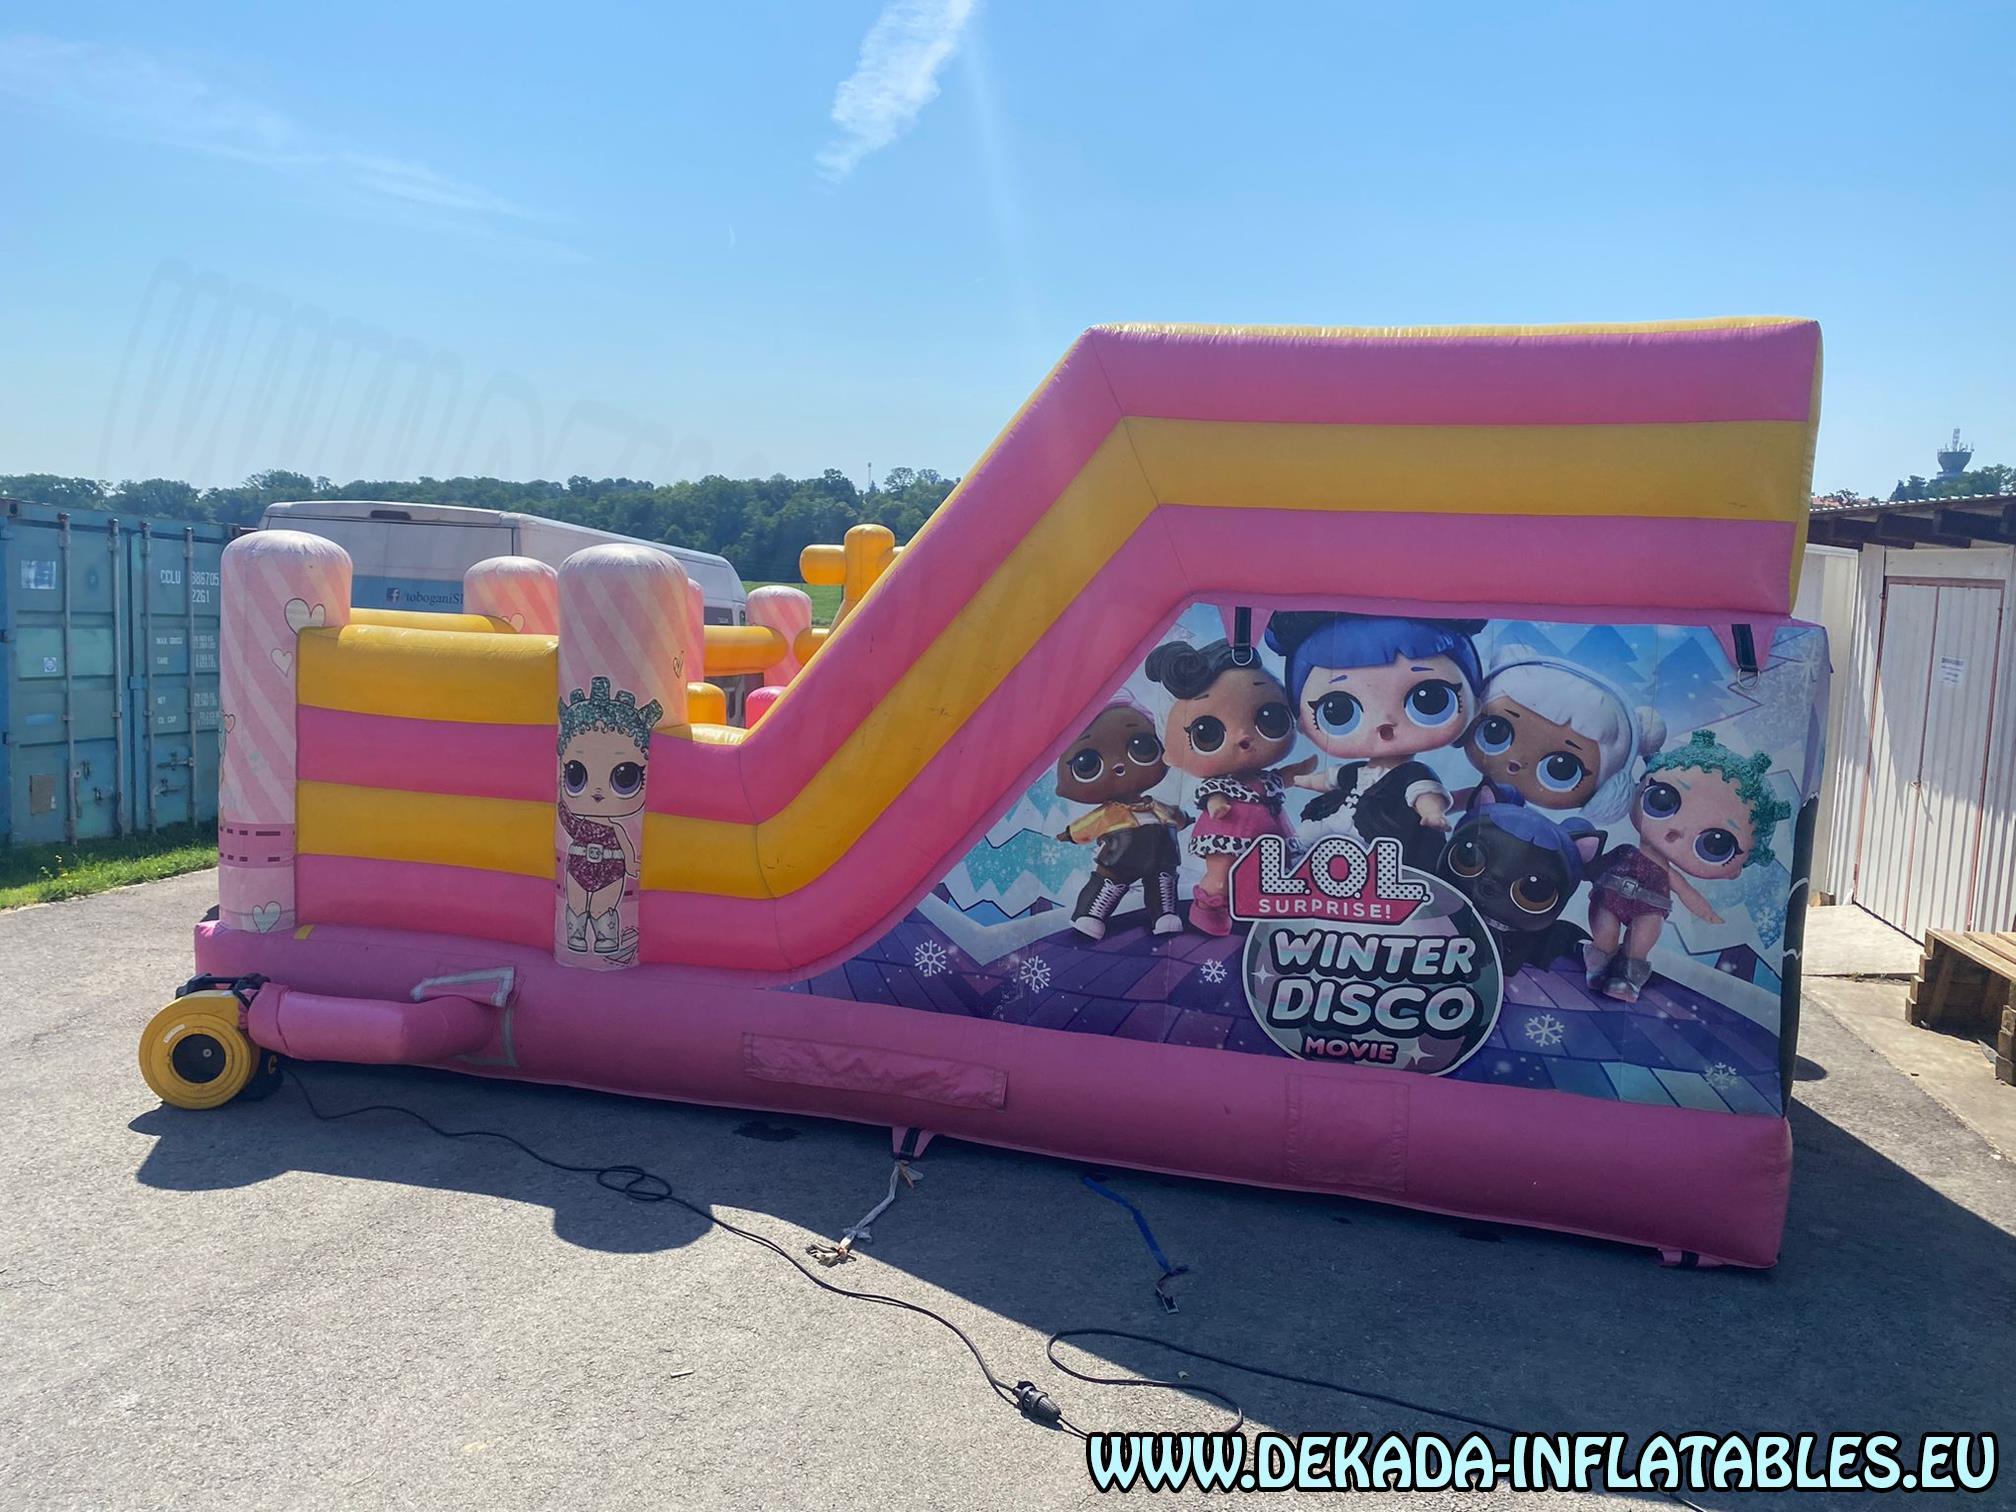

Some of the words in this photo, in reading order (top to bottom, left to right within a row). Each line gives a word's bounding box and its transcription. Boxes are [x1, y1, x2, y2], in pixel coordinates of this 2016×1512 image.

[160, 569, 181, 584] CCLU
[191, 588, 210, 603] 2261
[1258, 898, 1392, 920] SURPRISE!
[1272, 930, 1478, 976] WINTER
[1270, 977, 1477, 1033] DISCO
[1304, 1036, 1396, 1062] MOVIE
